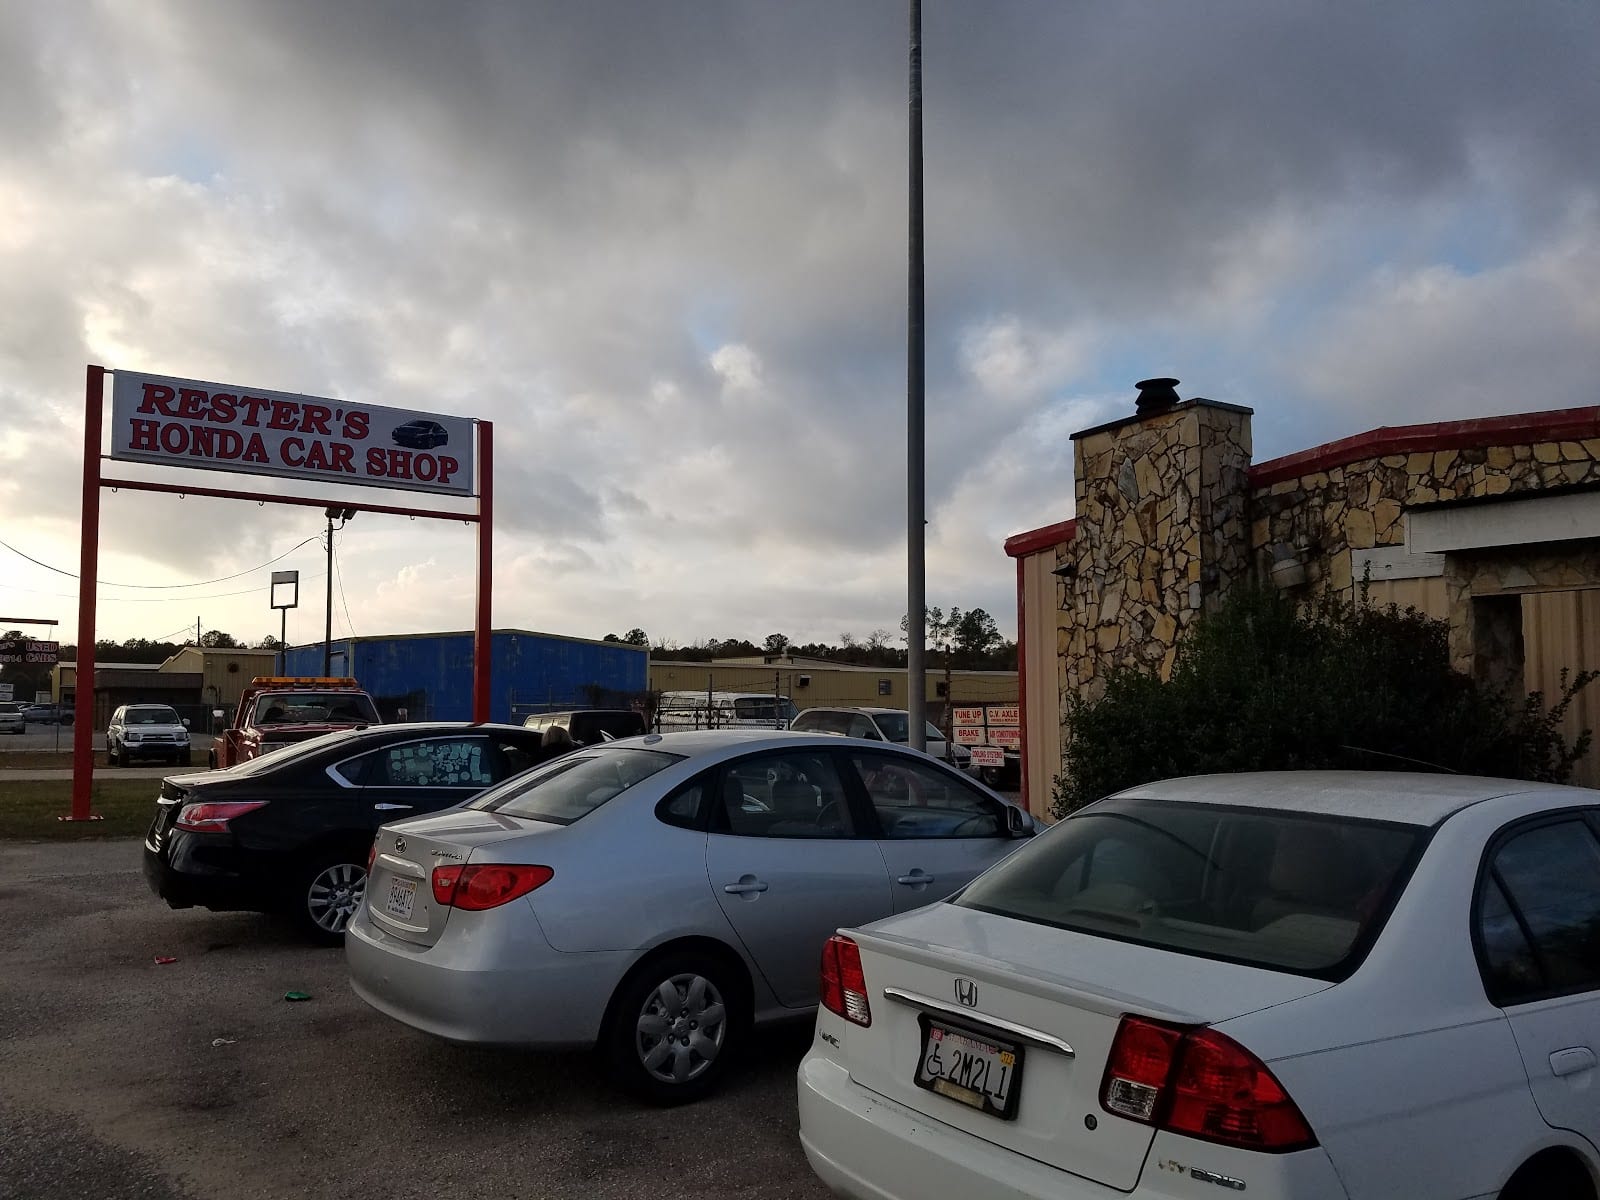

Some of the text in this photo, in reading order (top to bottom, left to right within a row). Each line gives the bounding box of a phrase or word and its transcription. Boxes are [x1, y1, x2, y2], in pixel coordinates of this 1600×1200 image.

[136, 383, 370, 440] RESTER'S
[129, 418, 459, 483] HONDA CAR SHOP
[25, 642, 57, 652] USED
[25, 653, 57, 662] CARS
[955, 711, 981, 719] TUNE UP
[948, 1049, 1007, 1101] 2M2L1
